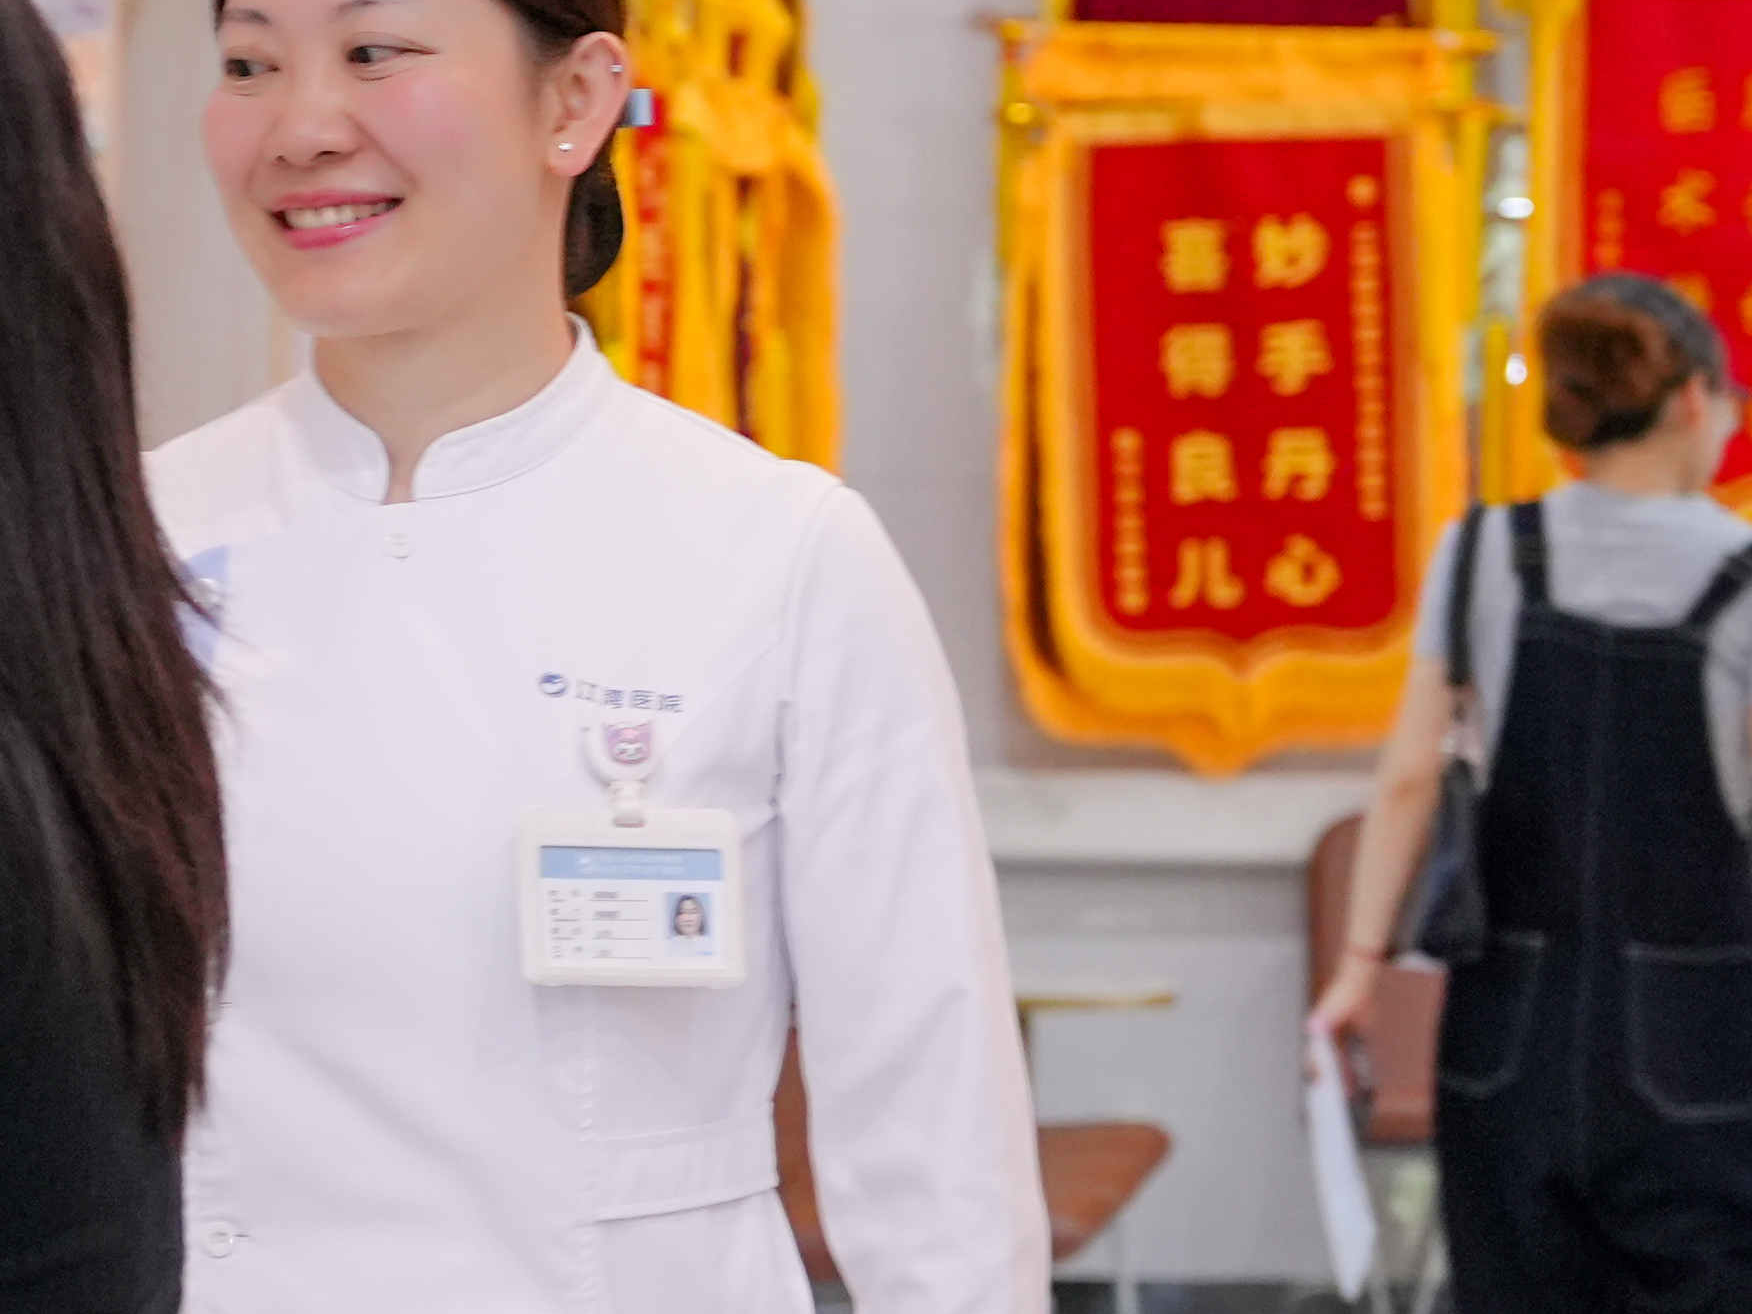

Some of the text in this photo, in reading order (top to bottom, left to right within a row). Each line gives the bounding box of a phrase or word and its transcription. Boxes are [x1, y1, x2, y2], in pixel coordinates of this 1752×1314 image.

[1252, 211, 1342, 608] 妙手丹心
[575, 679, 684, 714] 江湾医院
